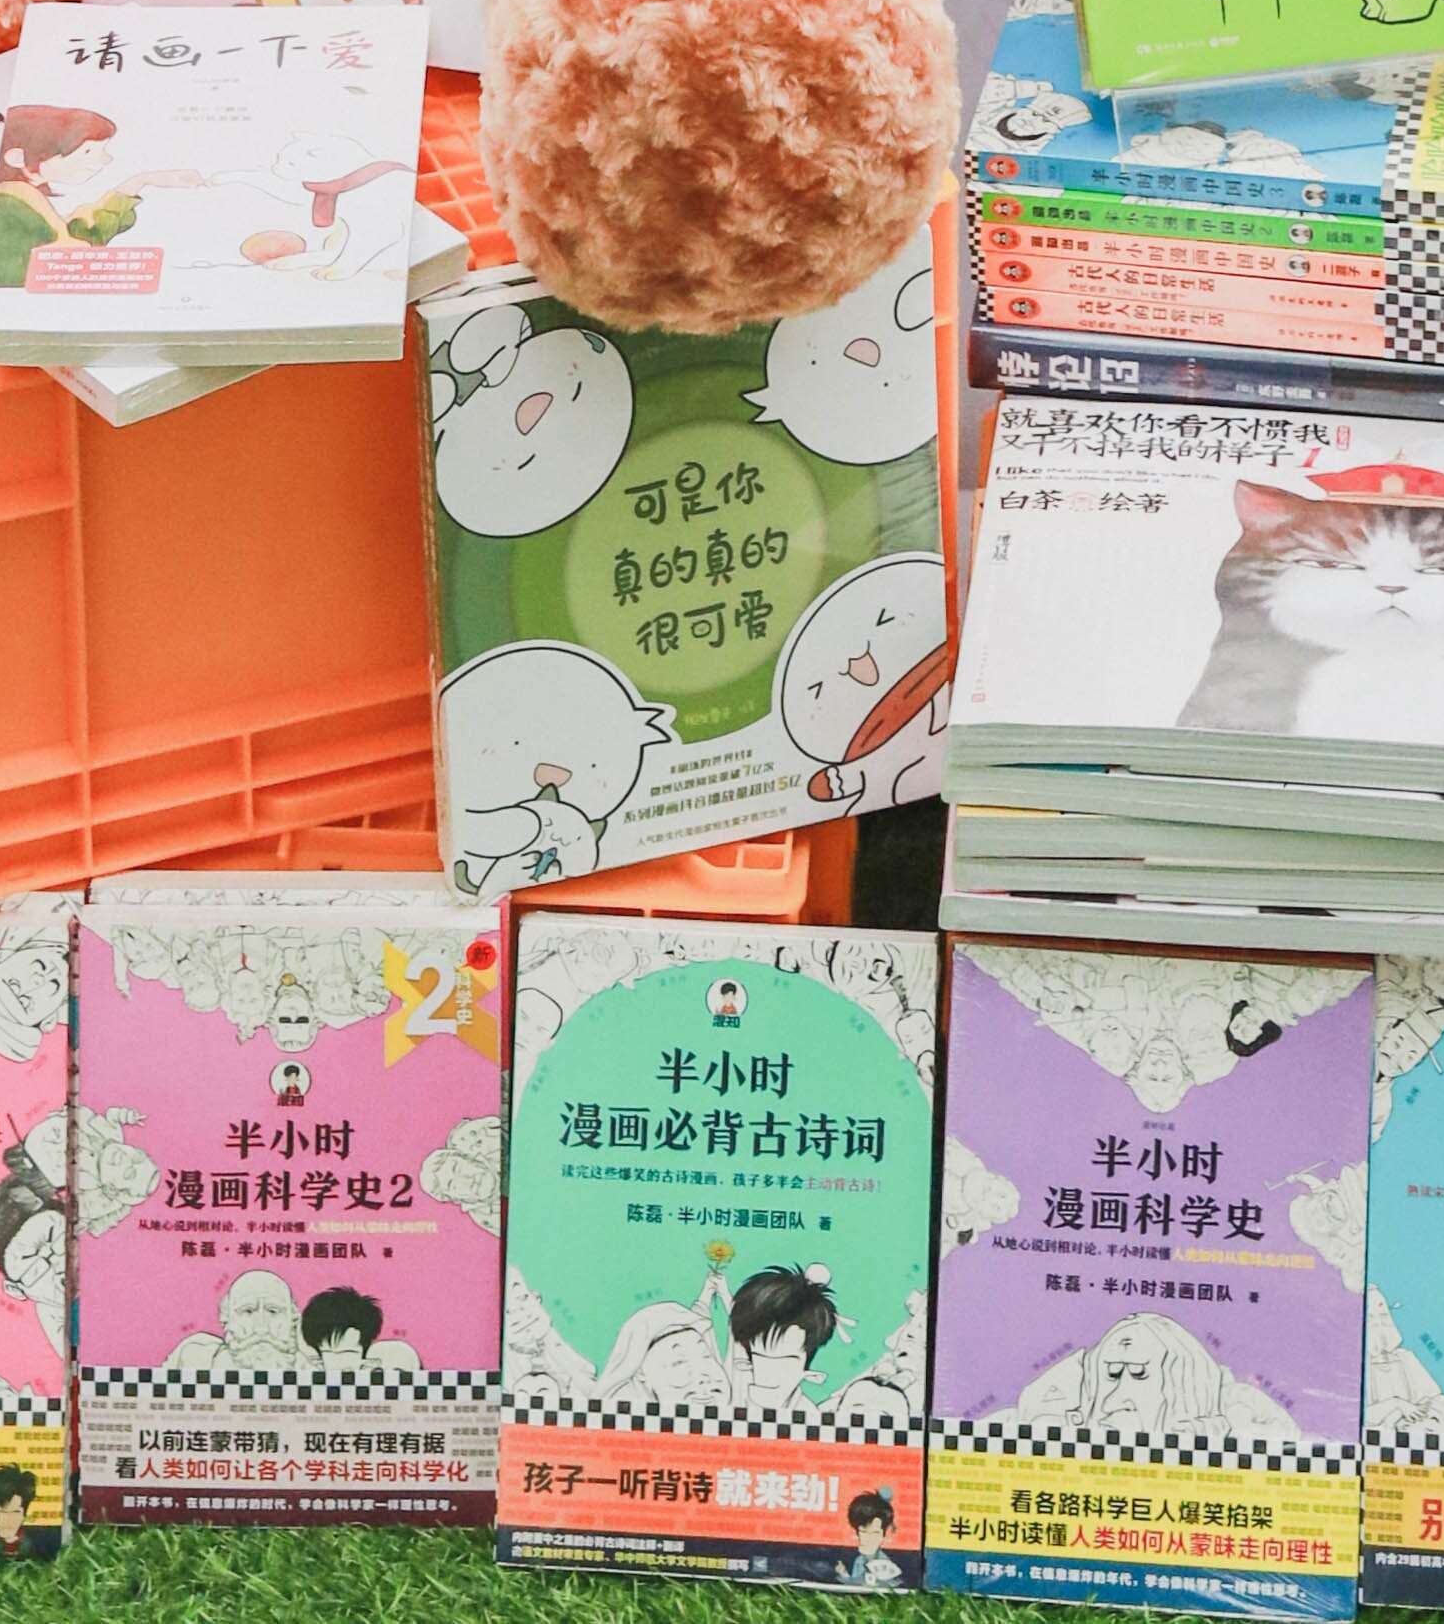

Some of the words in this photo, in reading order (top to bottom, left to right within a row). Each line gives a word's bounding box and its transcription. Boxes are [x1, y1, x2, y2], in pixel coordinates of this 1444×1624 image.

[66, 31, 373, 73] 请画一下爱
[1104, 243, 1278, 271] 半小时漫画中国史
[1067, 265, 1215, 293] 古代人的日常生活
[1077, 301, 1226, 327] 古代人的日常生活
[1001, 408, 1330, 445] 就喜欢你看不惯我
[999, 433, 1293, 467] 又干不掉我的样子
[625, 461, 765, 524] 可是你
[1000, 490, 1062, 511] 白茶
[1098, 493, 1169, 513] 绘著
[613, 527, 789, 606] 真的真的
[637, 590, 773, 656] 很可爱
[402, 952, 458, 1037] 2
[656, 1048, 794, 1097] 半小时
[224, 1119, 355, 1161] 半小时
[559, 1102, 885, 1163] 漫画必背古诗词
[1091, 1135, 1224, 1183] 半小时
[164, 1169, 414, 1210] 漫画科学史2
[1044, 1187, 1264, 1240] 漫画科学史
[138, 1429, 445, 1455] 以前连蒙带猜,现在有理有据
[114, 1457, 469, 1484] 看人类如何让各个学科走向科学化
[524, 1461, 840, 1513] 孩子一听背诗就来劲!
[1010, 1488, 1273, 1530] 看各路科学巨人爆笑掐架
[950, 1515, 1333, 1566] 半小时读懂人类如何从蒙昧走向理性
